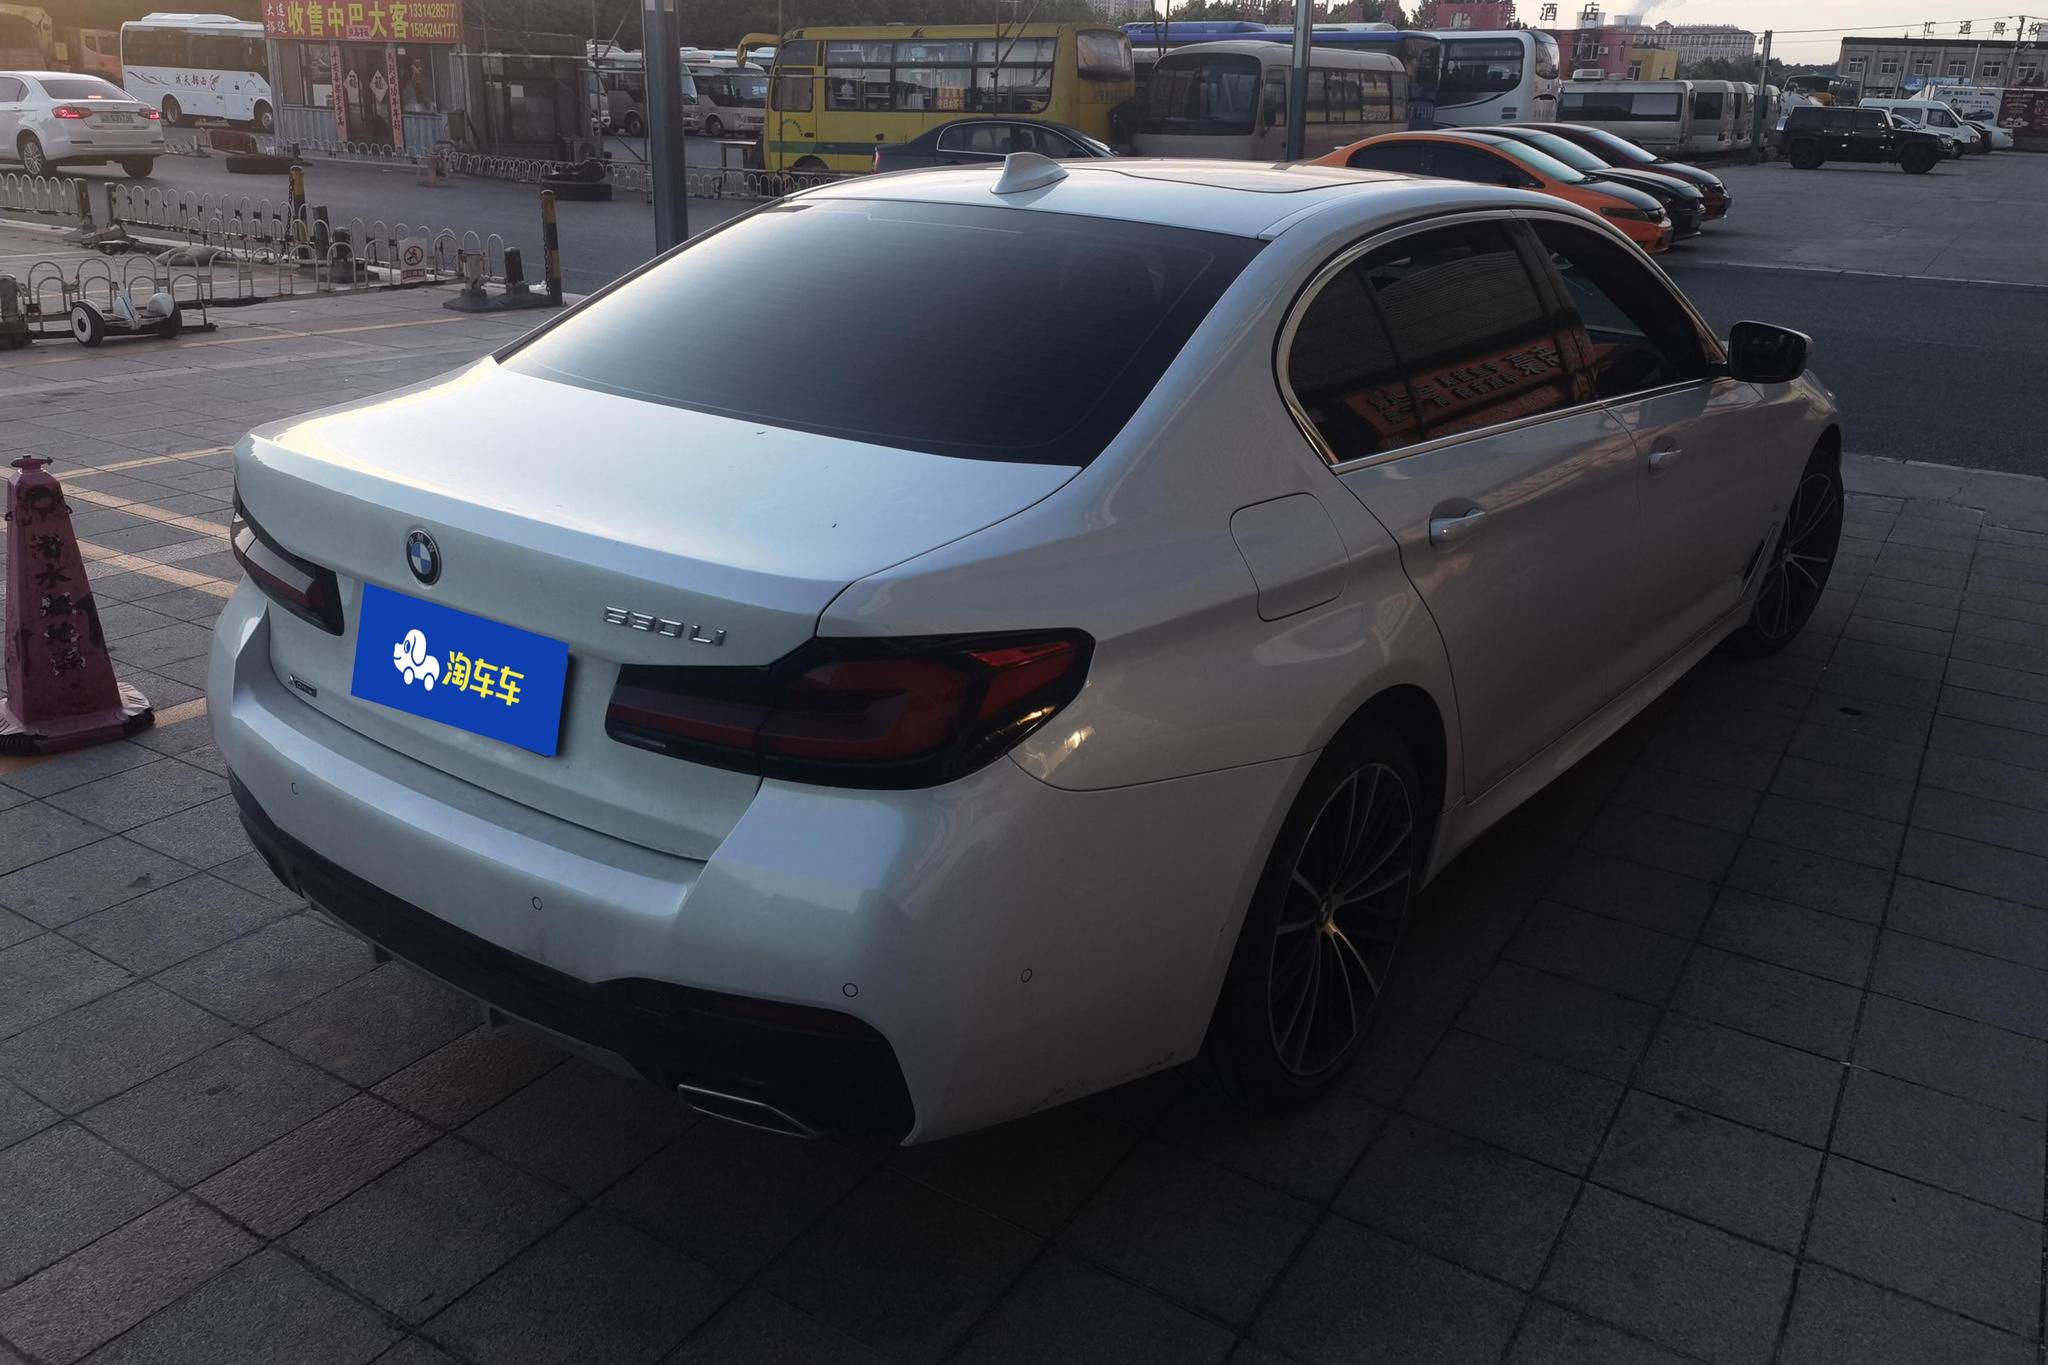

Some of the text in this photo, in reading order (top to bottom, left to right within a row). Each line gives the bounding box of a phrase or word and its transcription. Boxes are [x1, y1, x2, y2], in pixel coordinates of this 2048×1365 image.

[287, 1, 409, 38] 收售中巴大客
[408, 3, 459, 18] 1331428577
[410, 22, 460, 38] 1584244177
[408, 532, 435, 553] BMW
